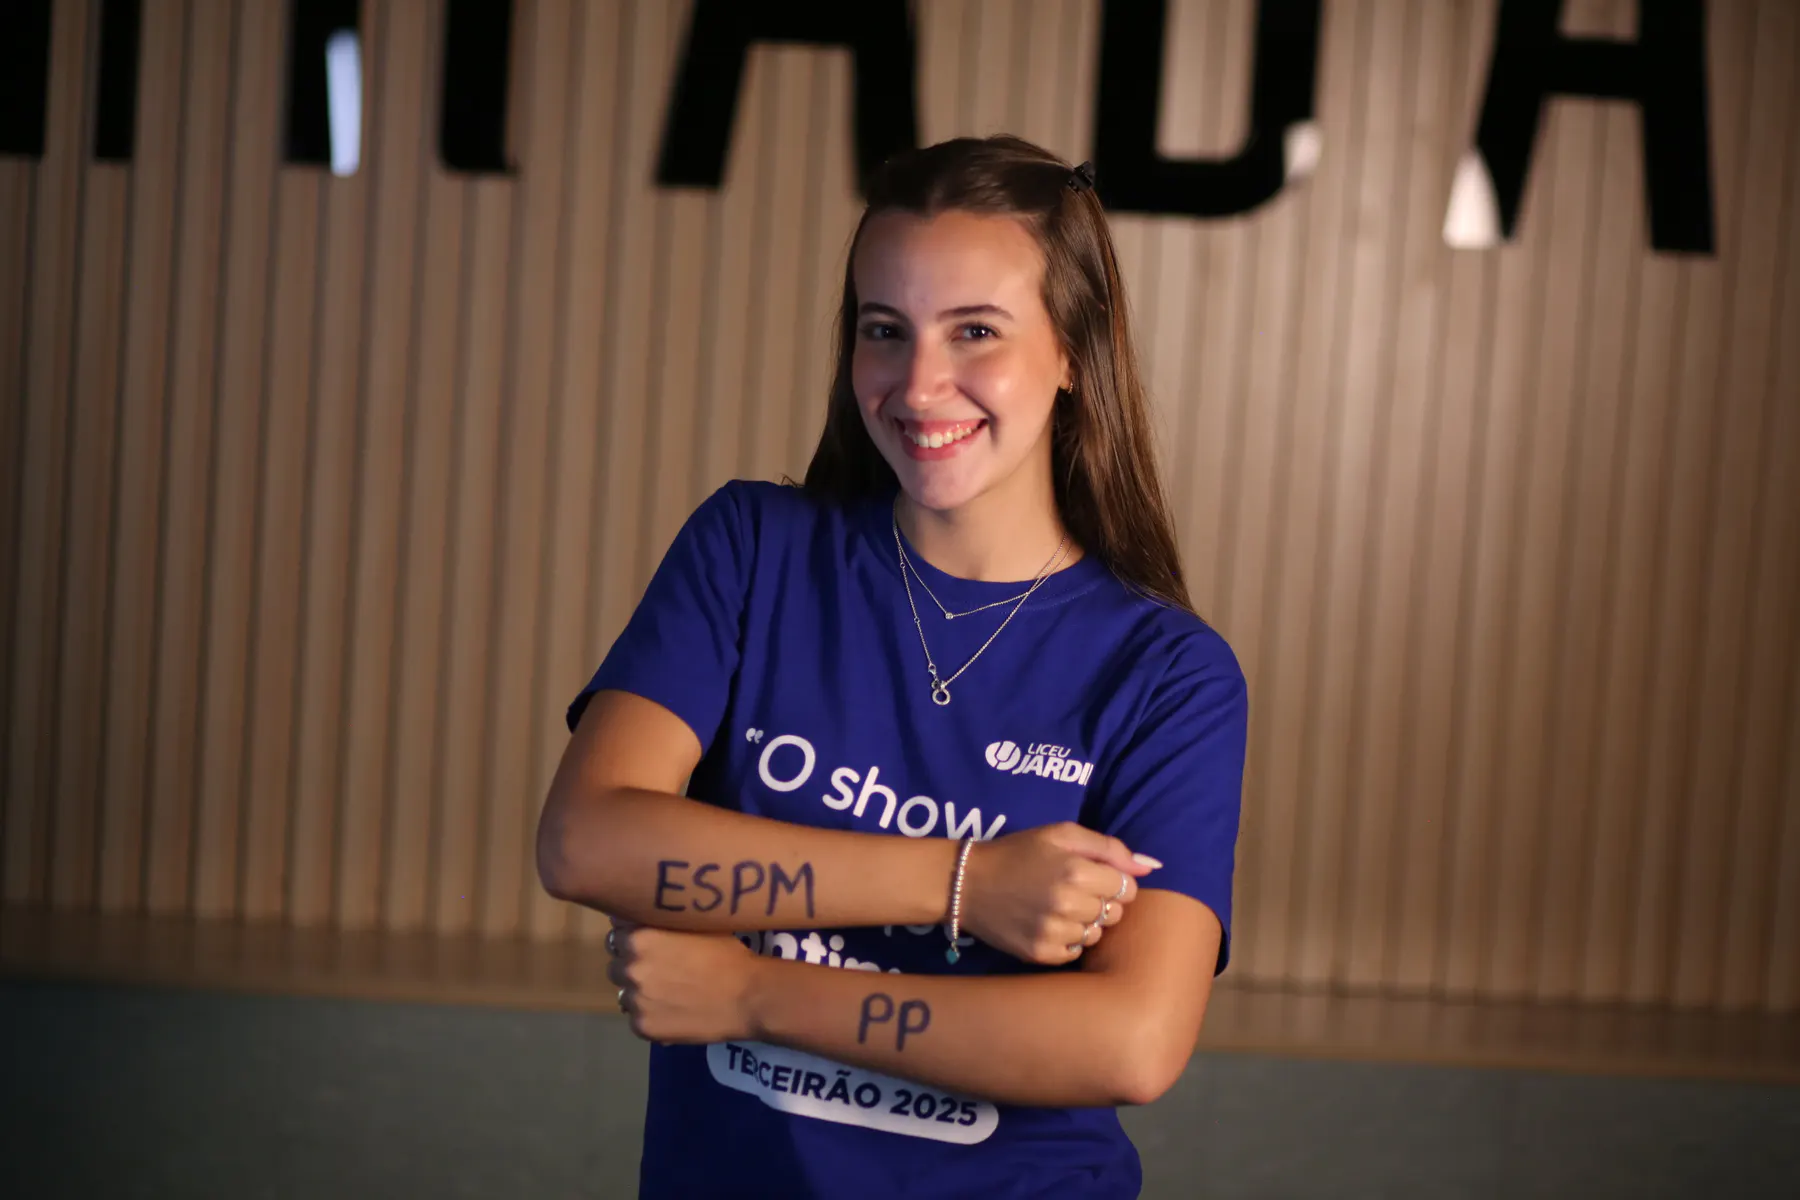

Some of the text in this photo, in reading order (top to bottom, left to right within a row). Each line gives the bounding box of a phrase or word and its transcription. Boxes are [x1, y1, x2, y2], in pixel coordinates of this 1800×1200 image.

[1012, 755, 1094, 786] JARDI
[1027, 743, 1072, 758] LICEU
[822, 766, 1007, 841] show
[654, 860, 815, 919] ESPM
[858, 992, 931, 1051] PP
[890, 1090, 978, 1126] 2025
